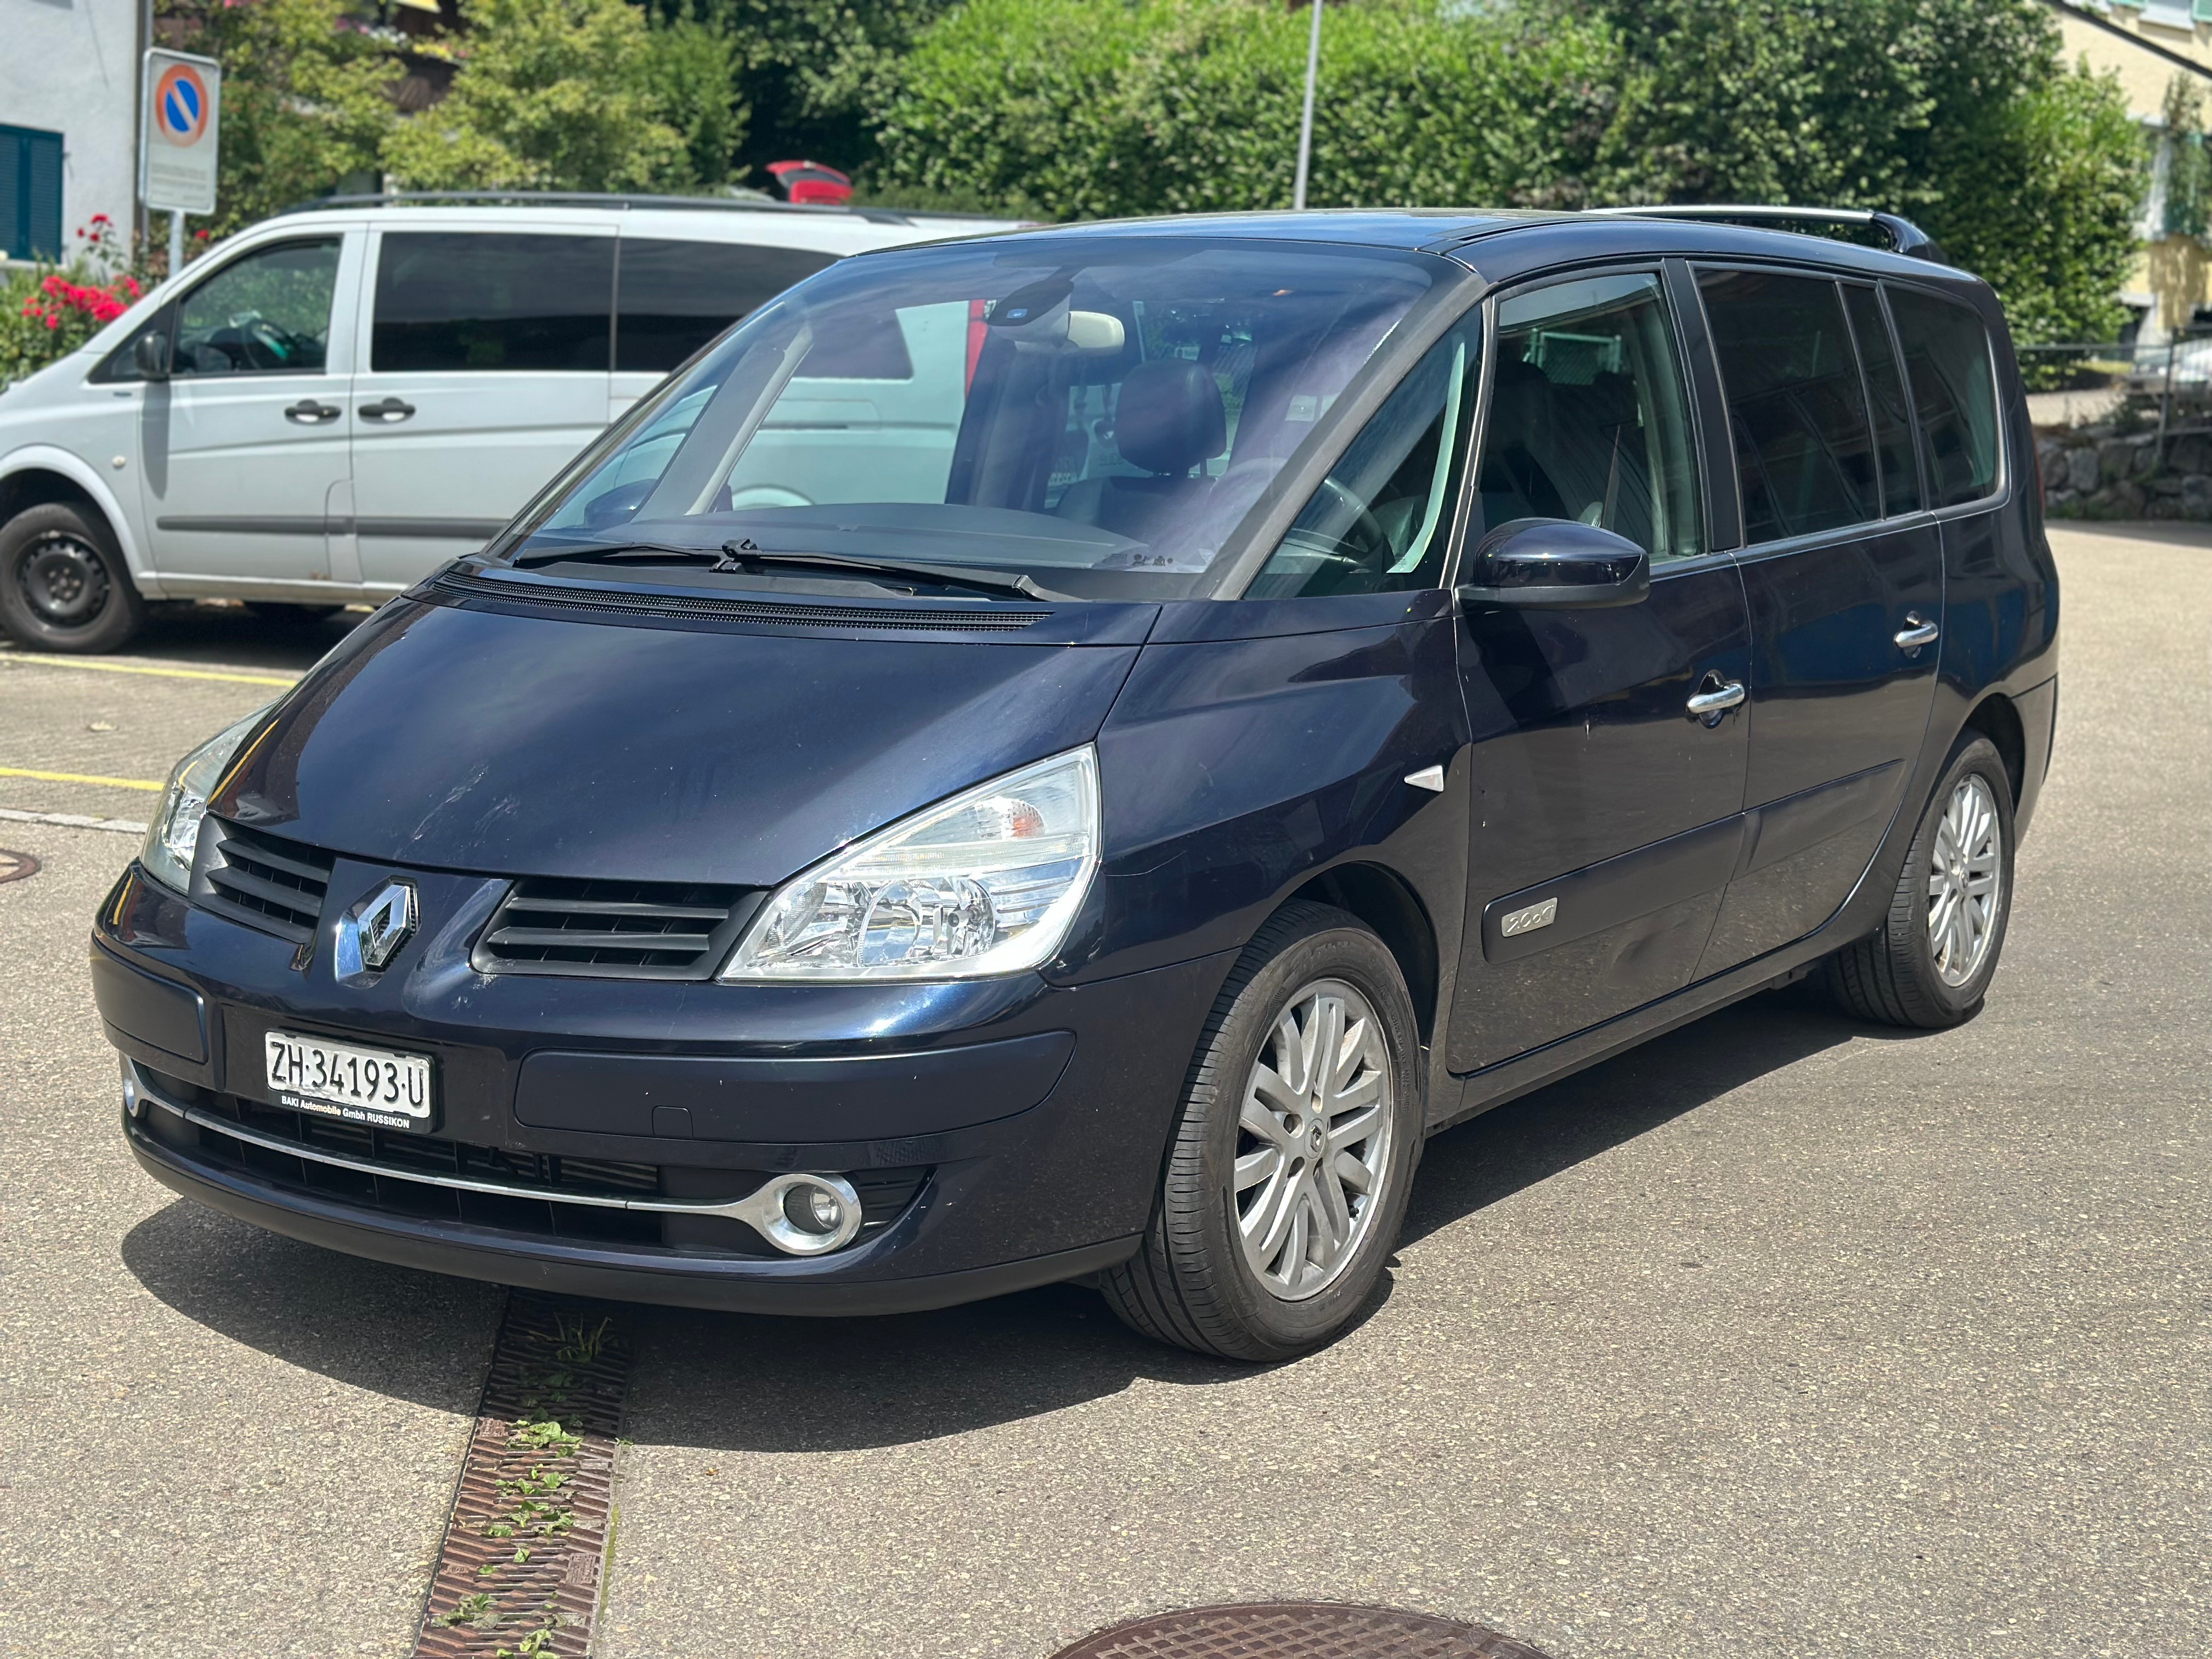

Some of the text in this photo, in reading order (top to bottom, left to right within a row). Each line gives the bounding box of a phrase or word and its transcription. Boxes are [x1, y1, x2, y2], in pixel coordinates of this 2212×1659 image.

[281, 1096, 410, 1129] BAKI Automobile Gmbh RUSSIKON
